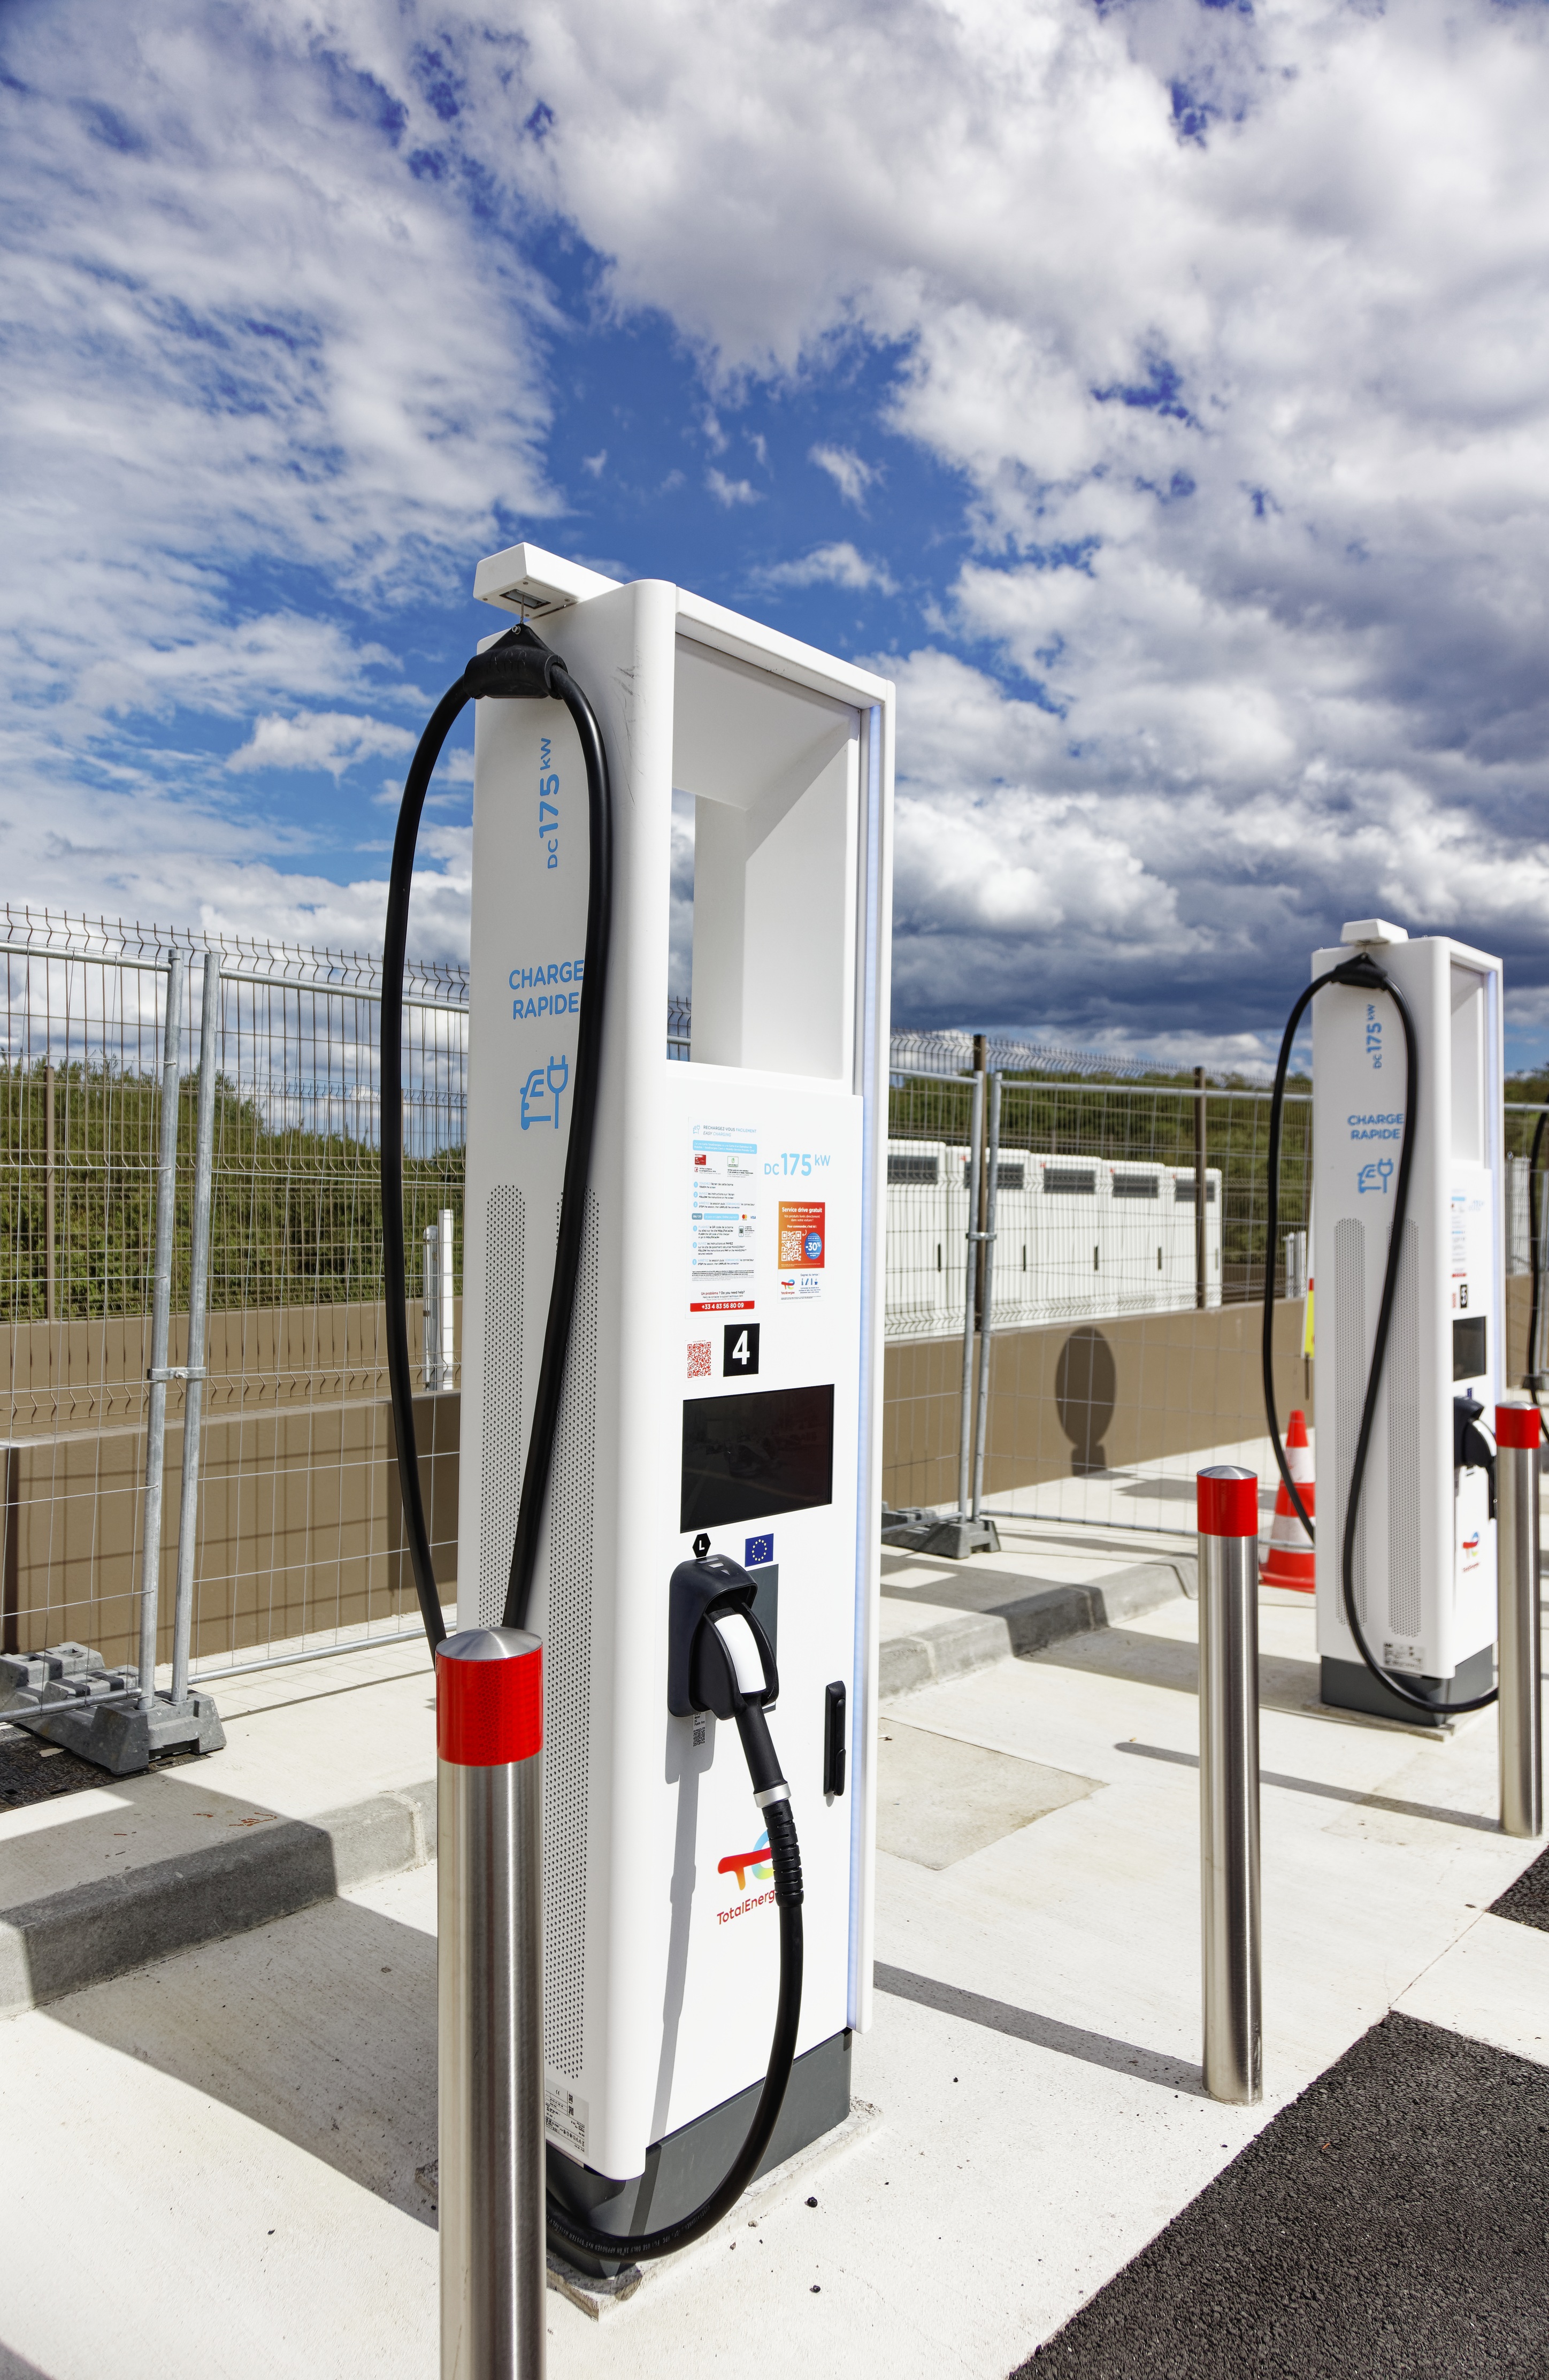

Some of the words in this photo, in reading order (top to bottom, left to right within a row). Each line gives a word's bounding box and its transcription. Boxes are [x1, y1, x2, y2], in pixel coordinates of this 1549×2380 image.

[540, 738, 551, 769] kW
[539, 774, 559, 838] 175
[547, 838, 557, 869] DC
[509, 960, 585, 990] CHARGE
[512, 992, 579, 1019] RAPIDE
[1367, 1004, 1375, 1020] kW
[1366, 1022, 1382, 1053] 175
[1373, 1054, 1382, 1069] DC
[1347, 1113, 1404, 1126] CHARGE
[1351, 1129, 1400, 1139] RAPIDE
[764, 1163, 779, 1175] DC
[780, 1153, 811, 1175] 175
[815, 1154, 831, 1166] kW
[806, 1242, 820, 1251] -30%
[732, 1330, 750, 1365] 4
[699, 1540, 704, 1551] L
[549, 2218, 569, 2238] ASSEMBLY
[569, 2233, 585, 2246] SYSTEM
[595, 2244, 616, 2254] APPROVED
[630, 2245, 641, 2253] ONLY
